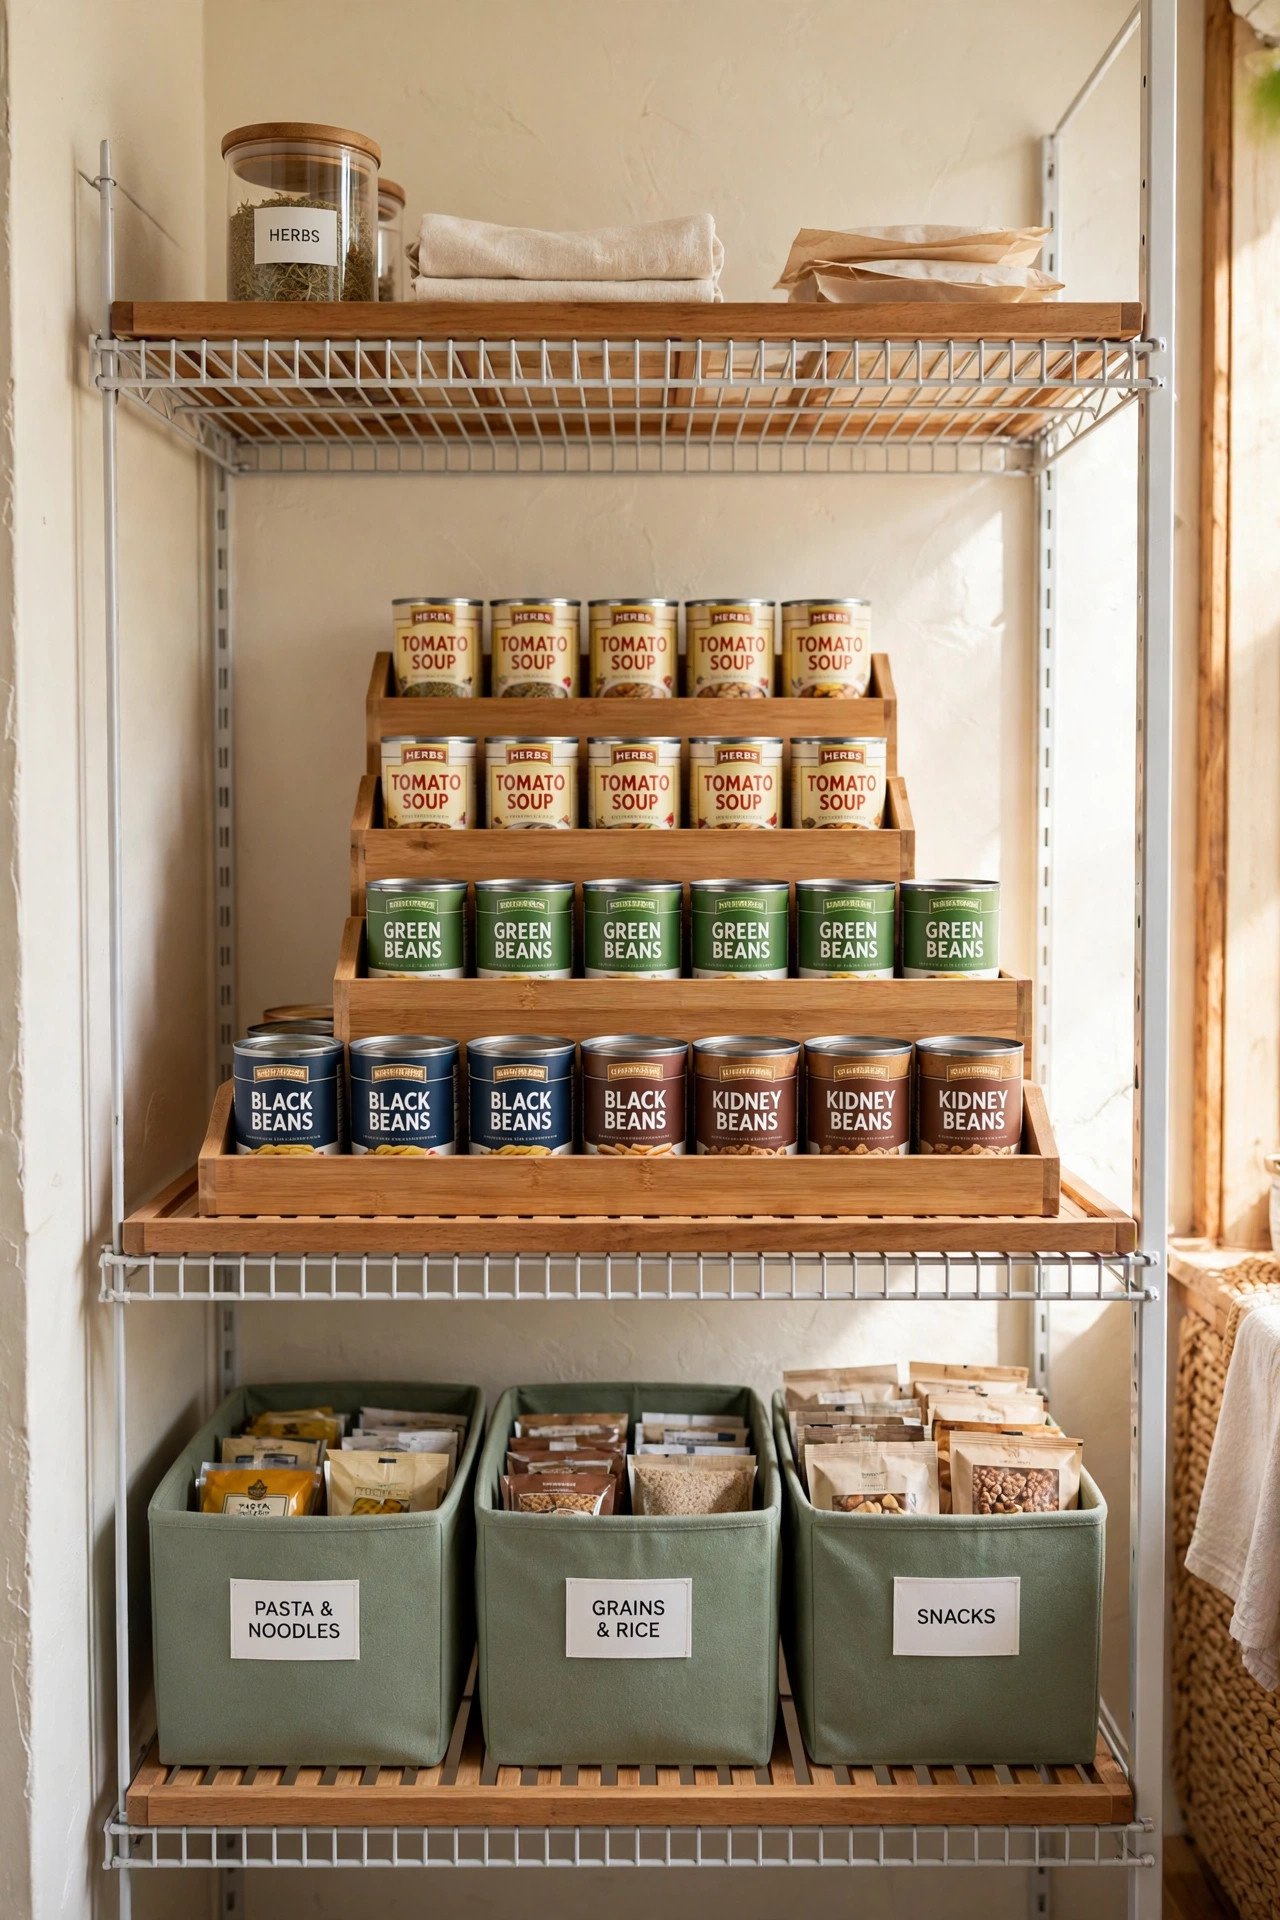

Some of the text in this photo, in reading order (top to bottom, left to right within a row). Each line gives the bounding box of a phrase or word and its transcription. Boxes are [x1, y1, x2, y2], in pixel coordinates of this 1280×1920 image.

[269, 228, 320, 243] HERBS
[402, 636, 468, 652] TOMATO
[501, 636, 567, 652] TOMATO
[601, 636, 667, 652] TOMATO
[699, 636, 765, 652] TOMATO
[797, 636, 863, 652] TOMATO
[412, 654, 456, 670] SOUP
[511, 654, 556, 670] SOUP
[611, 654, 656, 670] SOUP
[710, 654, 754, 670] SOUP
[808, 654, 852, 670] SOUP
[406, 750, 444, 761] HERBS
[510, 750, 549, 761] HERBS
[616, 750, 654, 761] HERBS
[720, 750, 758, 761] HERBS
[824, 750, 862, 761] HERBS
[392, 774, 461, 791] TOMATO
[496, 774, 565, 791] TOMATO
[600, 774, 670, 791] TOMATO
[704, 774, 773, 791] TOMATO
[808, 774, 877, 791] TOMATO
[402, 793, 448, 810] SOUP
[507, 793, 554, 810] SOUP
[612, 793, 658, 810] SOUP
[716, 793, 762, 810] SOUP
[820, 793, 866, 810] SOUP
[383, 921, 441, 939] GREEN
[494, 921, 551, 939] GREEN
[603, 921, 661, 939] GREEN
[712, 921, 770, 939] GREEN
[819, 921, 877, 939] GREEN
[925, 921, 983, 939] GREEN
[384, 940, 442, 959] BEANS
[495, 940, 552, 959] BEANS
[604, 940, 662, 959] BEANS
[712, 940, 770, 959] BEANS
[820, 940, 878, 959] BEANS
[926, 940, 984, 959] BEANS
[251, 1091, 313, 1110] BLACK
[369, 1091, 430, 1110] BLACK
[490, 1091, 552, 1110] BLACK
[604, 1090, 667, 1110] BLACK
[712, 1090, 782, 1110] KIDNEY
[826, 1090, 896, 1110] KIDNEY
[939, 1090, 1008, 1110] KIDNEY
[251, 1111, 313, 1131] BEANS
[369, 1111, 431, 1131] BEANS
[490, 1111, 552, 1131] BEANS
[604, 1111, 667, 1131] BEANS
[716, 1111, 779, 1131] BEANS
[830, 1111, 892, 1131] BEANS
[943, 1111, 1005, 1131] BEANS
[255, 1600, 333, 1616] PASTA &
[592, 1600, 665, 1616] GRAINS
[917, 1608, 996, 1624] SNACKS
[249, 1622, 340, 1639] NOODLES
[596, 1622, 660, 1638] & RICE
